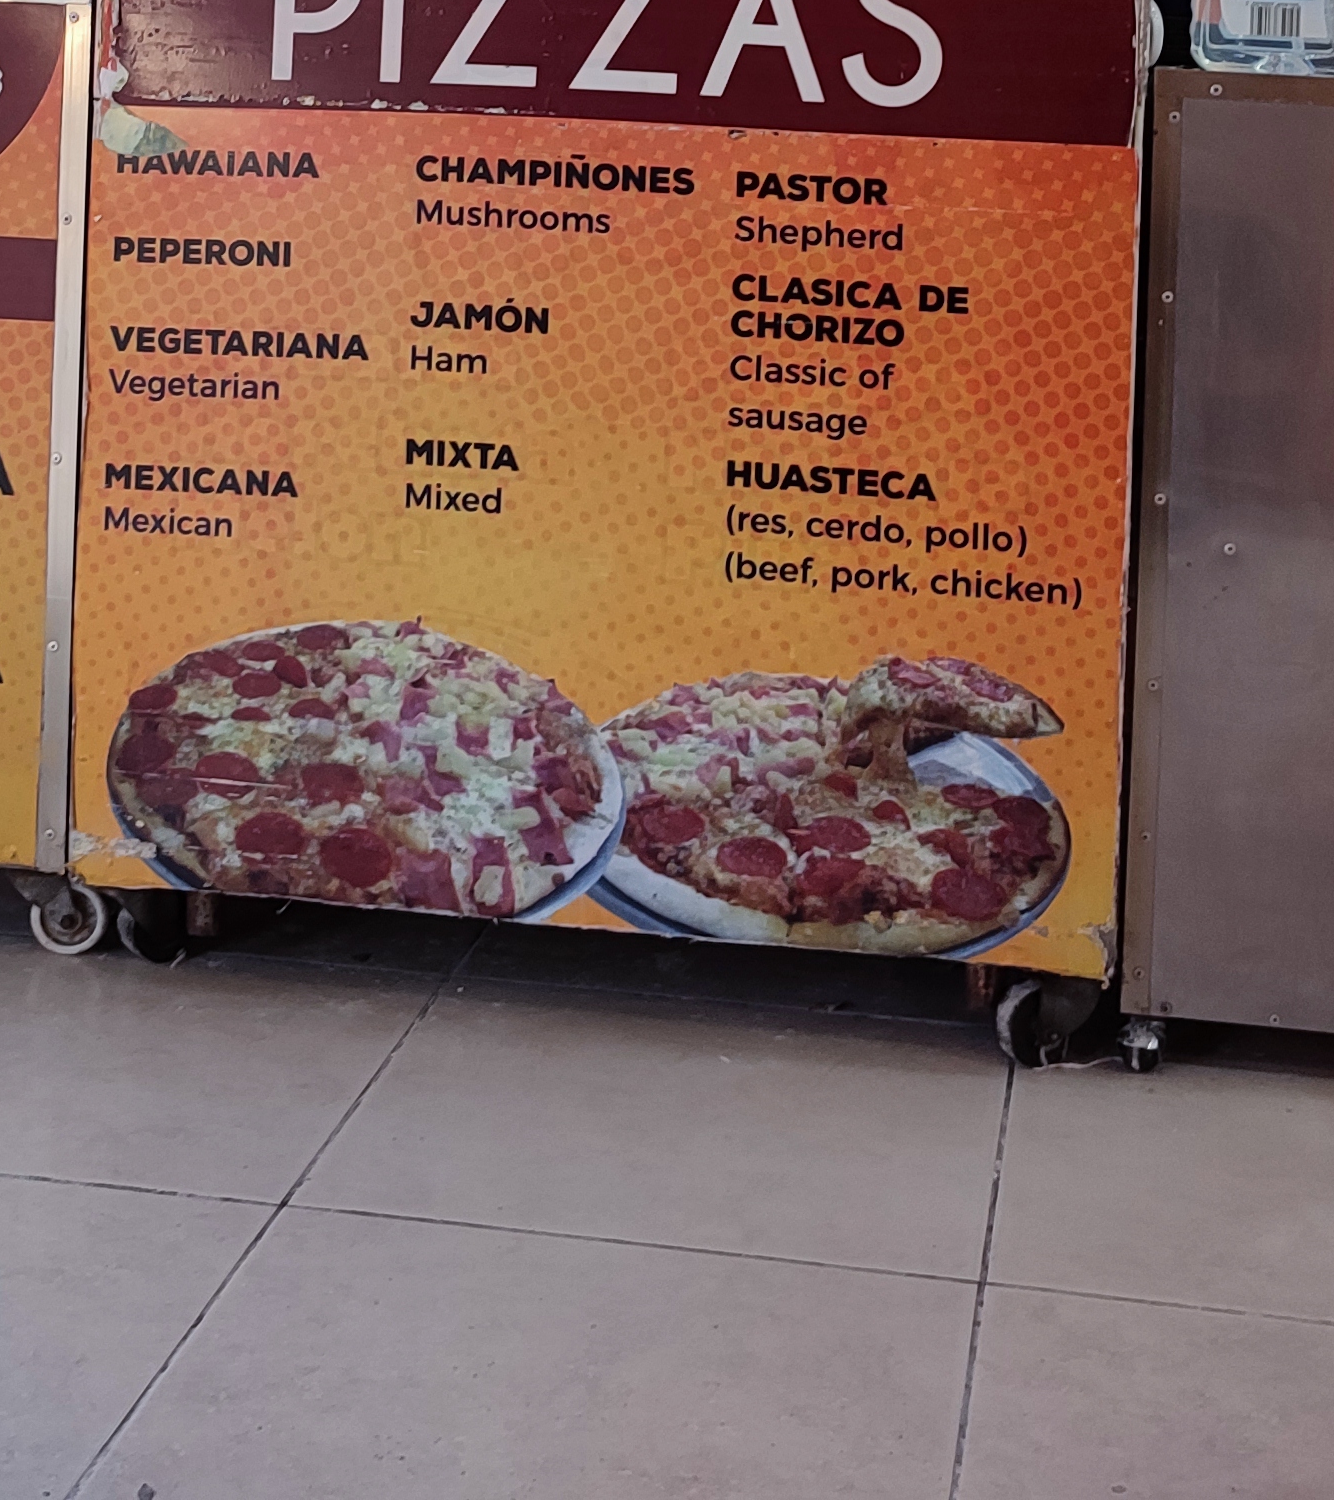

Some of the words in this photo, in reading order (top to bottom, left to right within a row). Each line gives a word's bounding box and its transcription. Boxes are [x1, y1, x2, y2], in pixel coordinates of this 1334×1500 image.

[117, 149, 320, 178] HAWAIANA
[416, 154, 696, 196] CHAMPIÑONES
[735, 171, 889, 206] PASTOR
[416, 199, 612, 234] Mushrooms
[734, 215, 905, 252] Shepherd
[113, 236, 292, 268] PEPERONI
[731, 273, 903, 311] CLASICA
[918, 284, 970, 315] DE
[410, 298, 550, 335] JAMÓN
[730, 310, 905, 348] CHORIZO
[110, 326, 369, 361] VEGETARIANA
[410, 344, 488, 375] Ham
[109, 369, 280, 402] Vegetarian
[729, 355, 847, 388] Classic
[858, 363, 895, 391] of
[727, 405, 868, 441] sausage
[405, 438, 520, 472] MIXTA
[104, 463, 299, 498] MEXICANA
[726, 460, 937, 502] HUASTECA
[405, 483, 503, 514] Mixed
[103, 506, 233, 538] Mexican
[726, 504, 795, 539] (res,
[805, 515, 914, 549] cerdo,
[924, 522, 1028, 558] pollo)
[724, 551, 819, 588] (beef,
[830, 564, 919, 597] pork,
[929, 568, 1083, 611] chicken)
